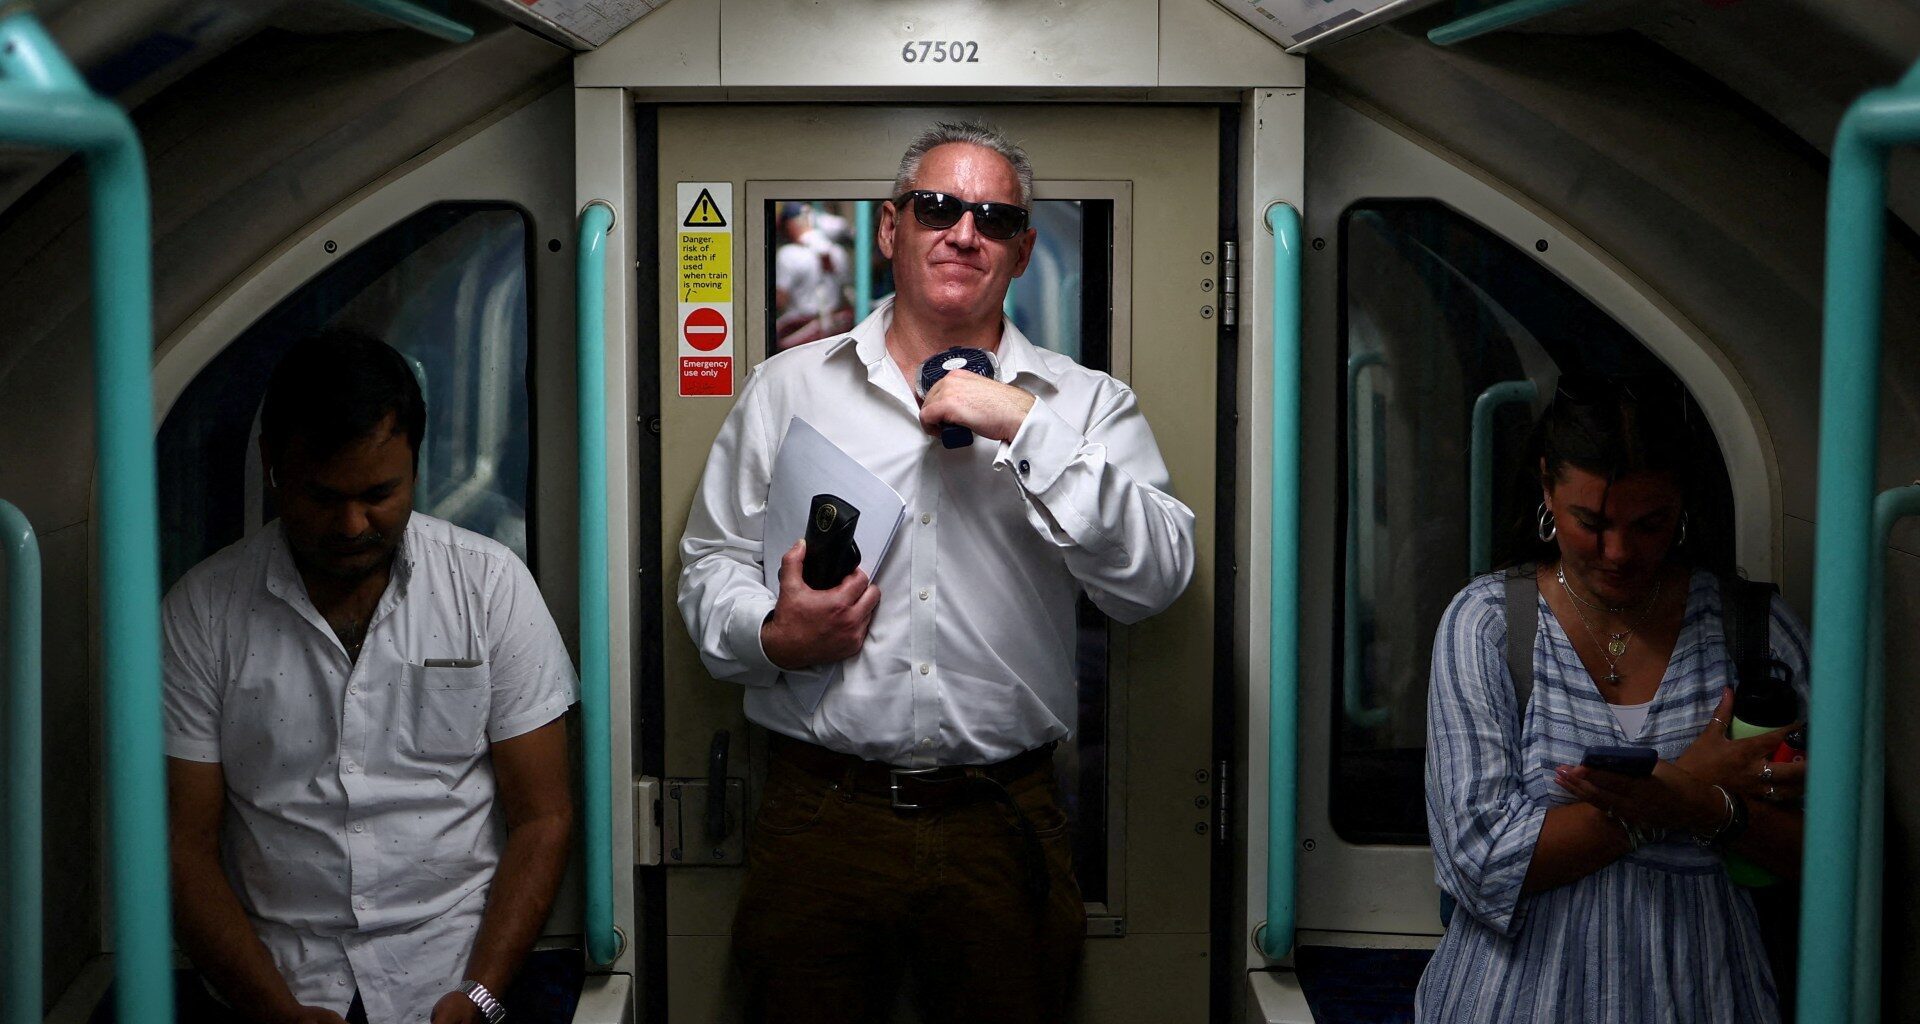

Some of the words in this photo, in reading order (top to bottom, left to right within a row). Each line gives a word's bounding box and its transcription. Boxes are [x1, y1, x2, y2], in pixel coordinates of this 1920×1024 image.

[902, 41, 978, 63] 67502
[683, 262, 703, 270] used
[684, 280, 690, 288] is
[692, 280, 722, 289] moving
[683, 360, 729, 369] Emergency
[701, 369, 719, 378] only
